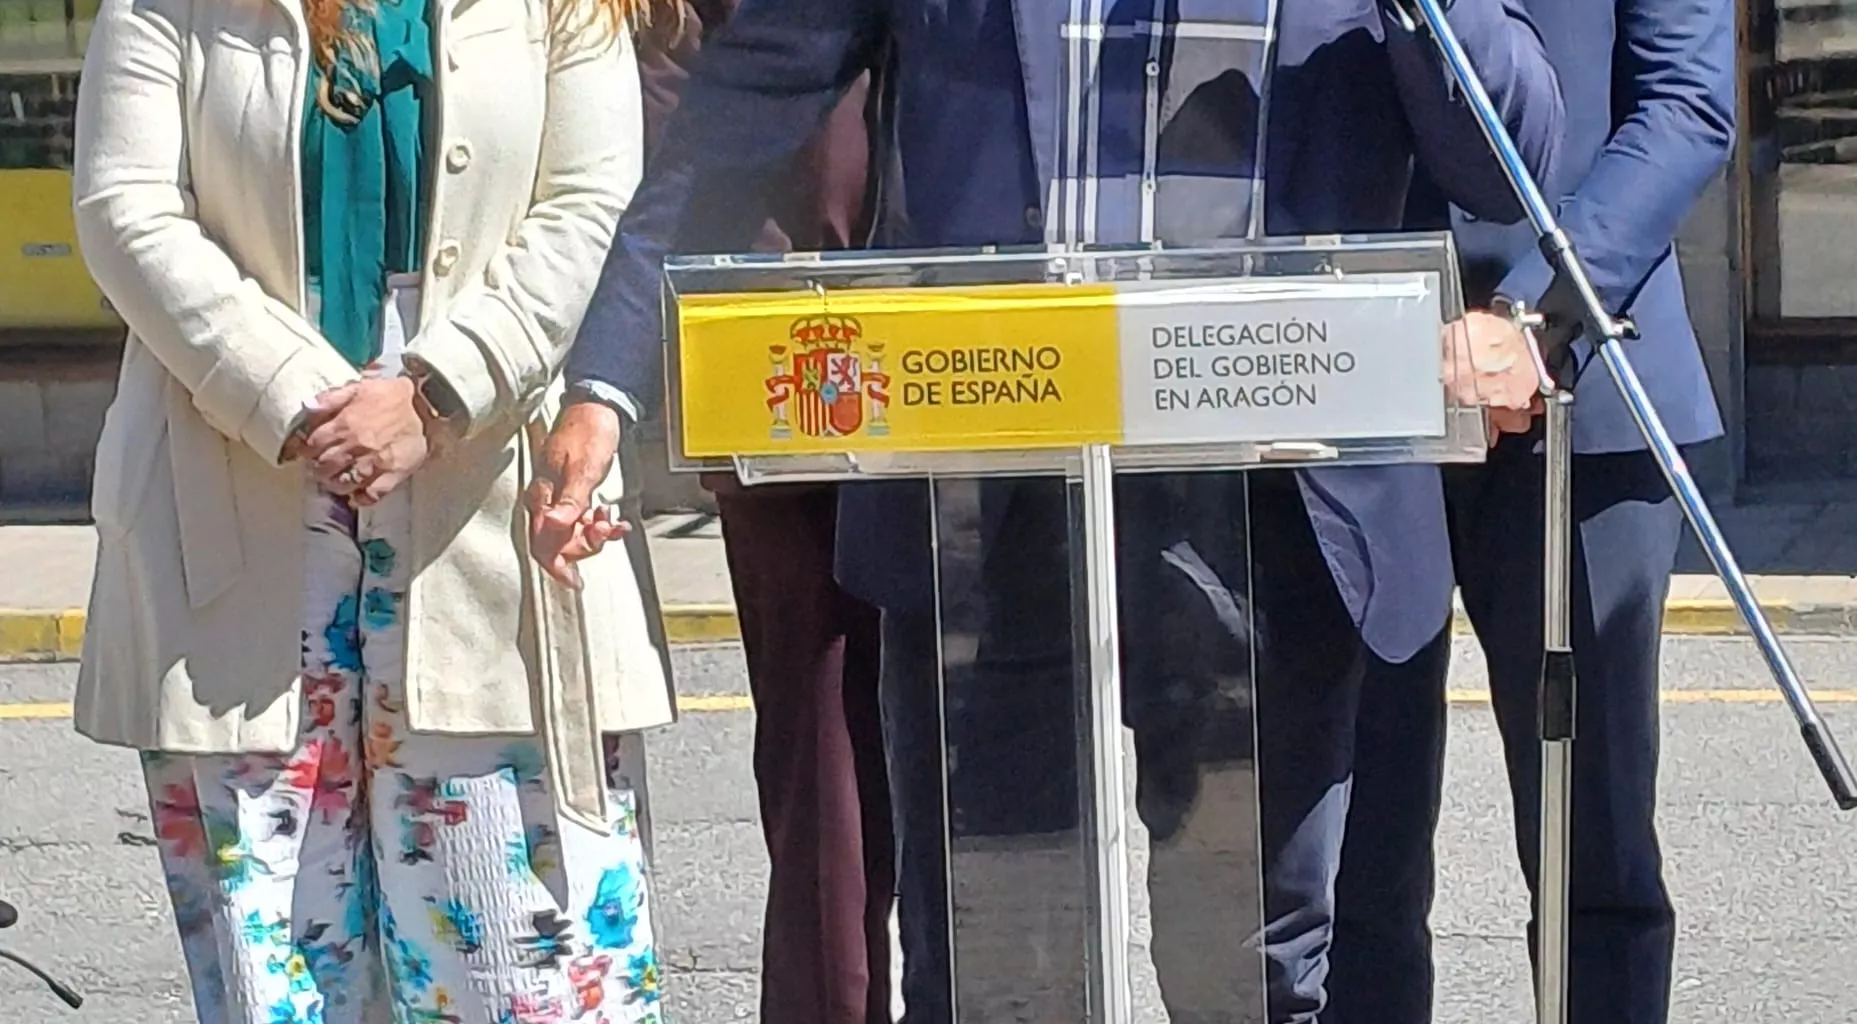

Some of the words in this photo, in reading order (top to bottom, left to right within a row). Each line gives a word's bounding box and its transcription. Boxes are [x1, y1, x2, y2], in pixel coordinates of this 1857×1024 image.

[1152, 317, 1327, 348] DELEGACIÓN
[902, 346, 1061, 374] GOBIERNO
[1154, 357, 1203, 379] DEL
[1211, 351, 1355, 376] GOBIERNO
[903, 382, 942, 406] DE
[952, 374, 1062, 405] ESPAÑA
[1155, 389, 1190, 410] EN
[1196, 380, 1316, 409] ARAGÓN
